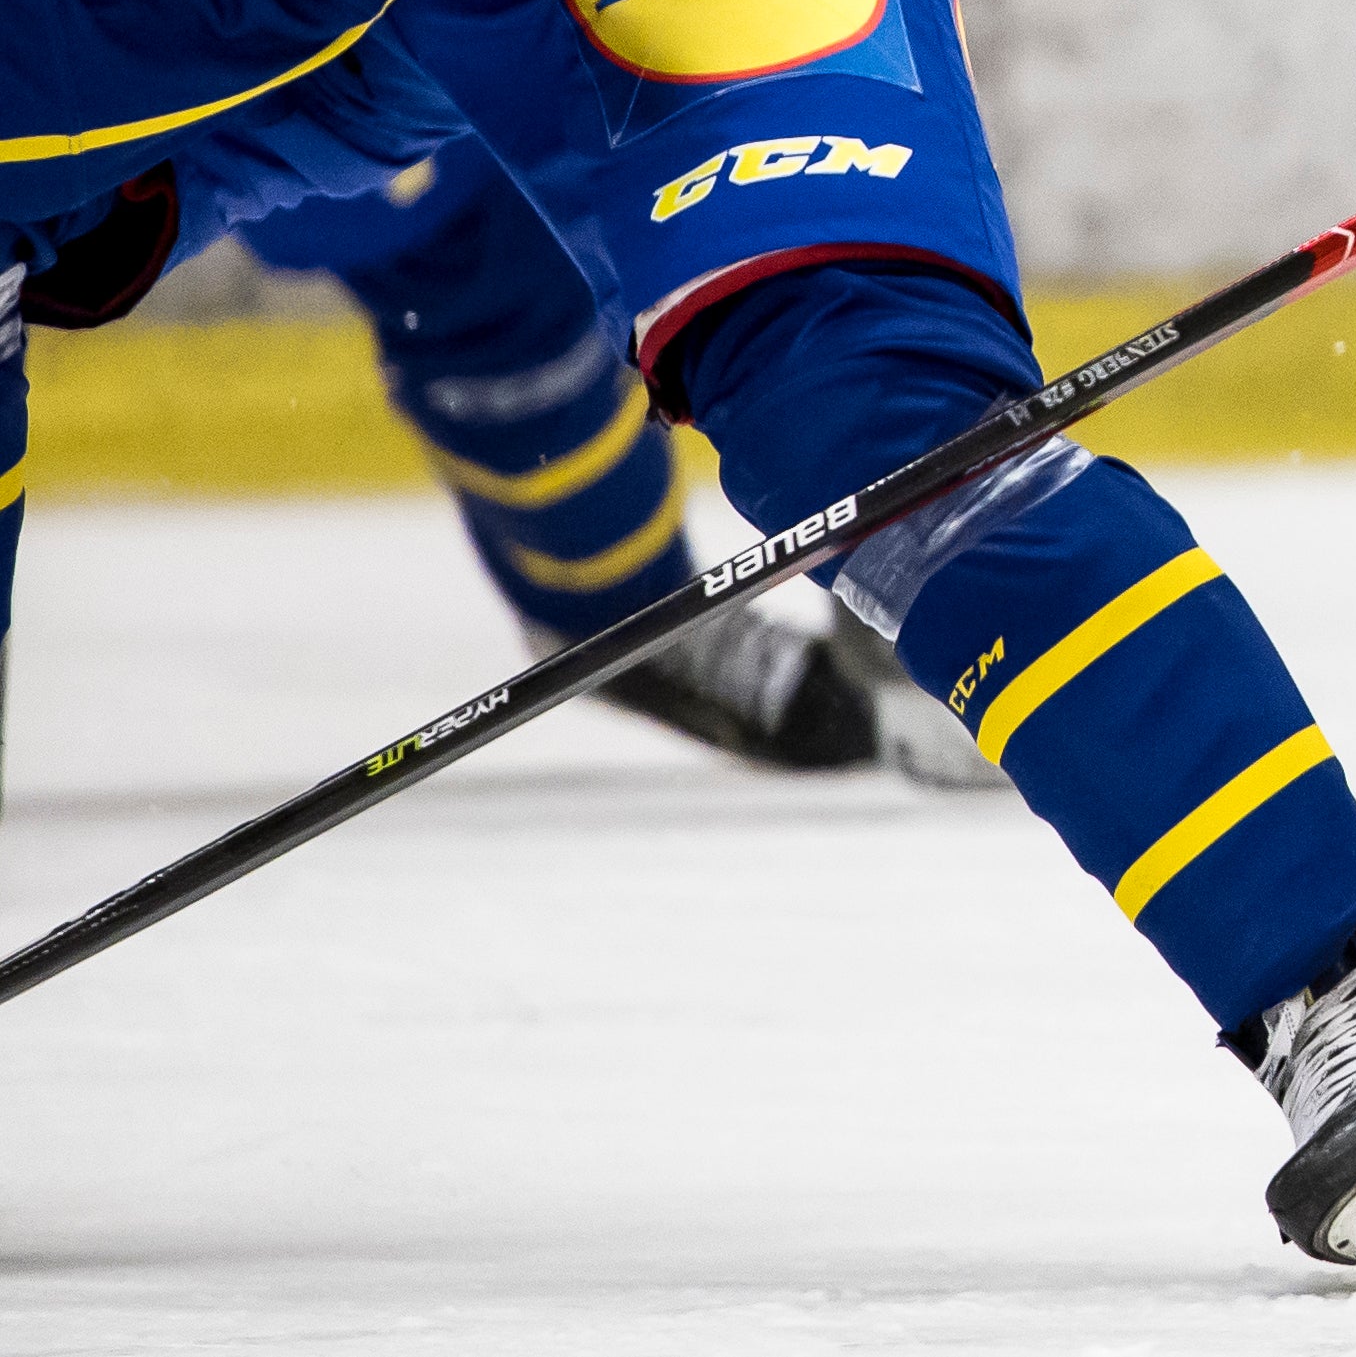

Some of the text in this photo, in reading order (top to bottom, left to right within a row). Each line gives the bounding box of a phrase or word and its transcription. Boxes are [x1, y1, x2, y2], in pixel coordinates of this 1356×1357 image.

[650, 134, 914, 224] CCM
[1077, 322, 1181, 389] STENBERG
[948, 634, 1006, 717] CCM
[366, 687, 510, 778] HYPERLITE
